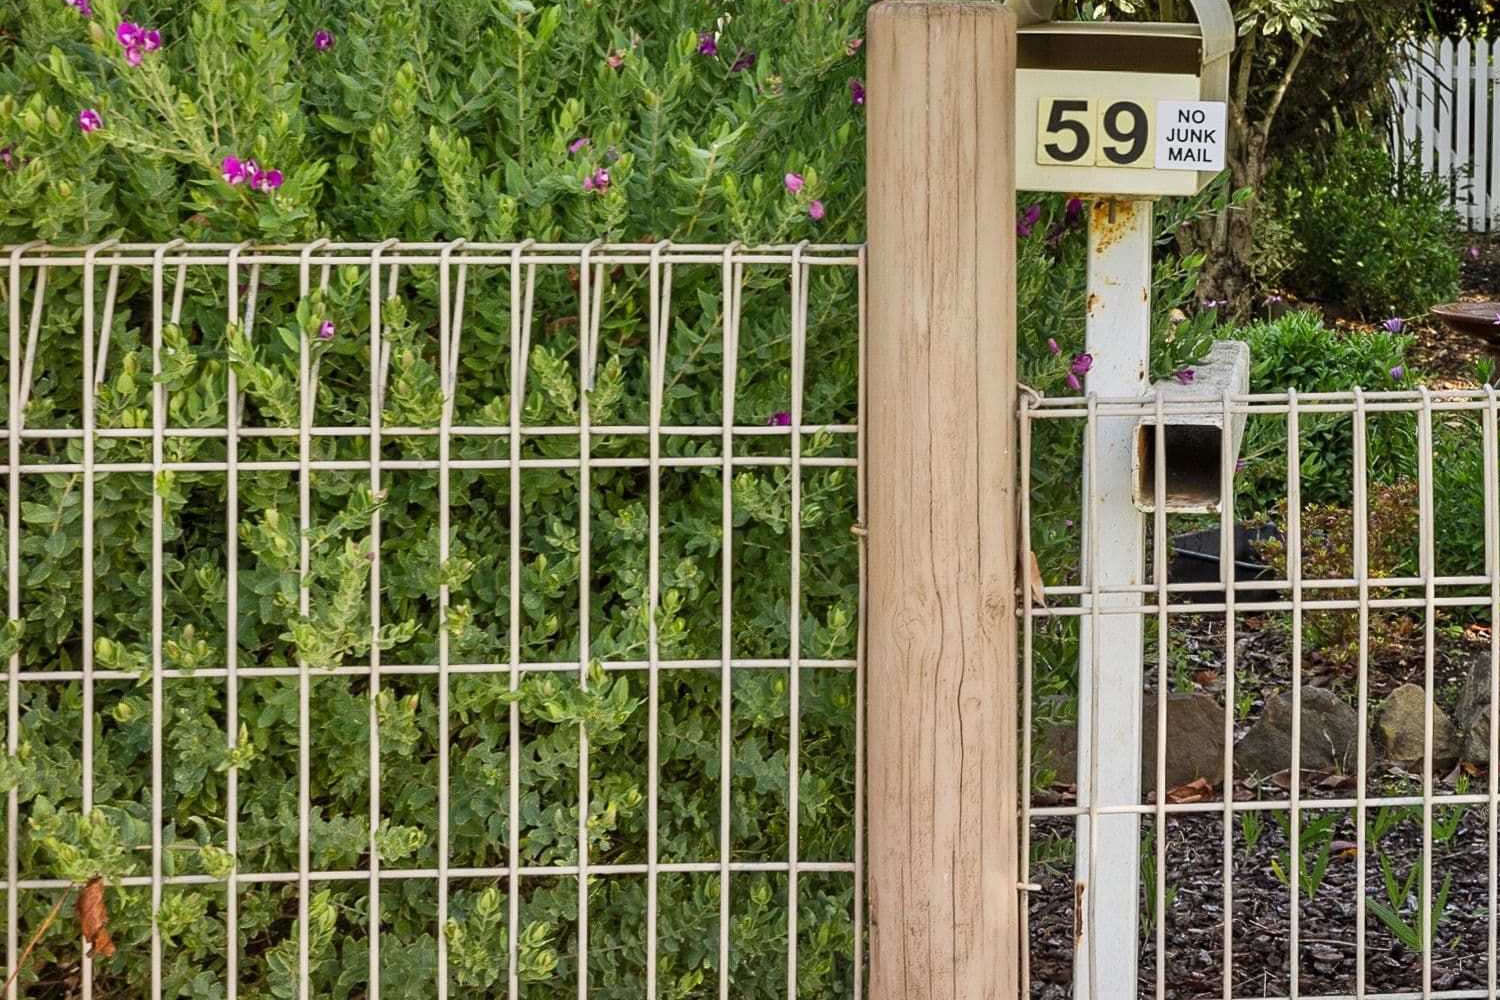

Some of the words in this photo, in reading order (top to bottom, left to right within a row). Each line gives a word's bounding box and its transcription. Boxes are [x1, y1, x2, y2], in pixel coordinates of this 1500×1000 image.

[1178, 109, 1206, 124] NO
[1044, 99, 1149, 164] 59
[1166, 128, 1216, 144] JUNK
[1168, 147, 1212, 163] MAIL
